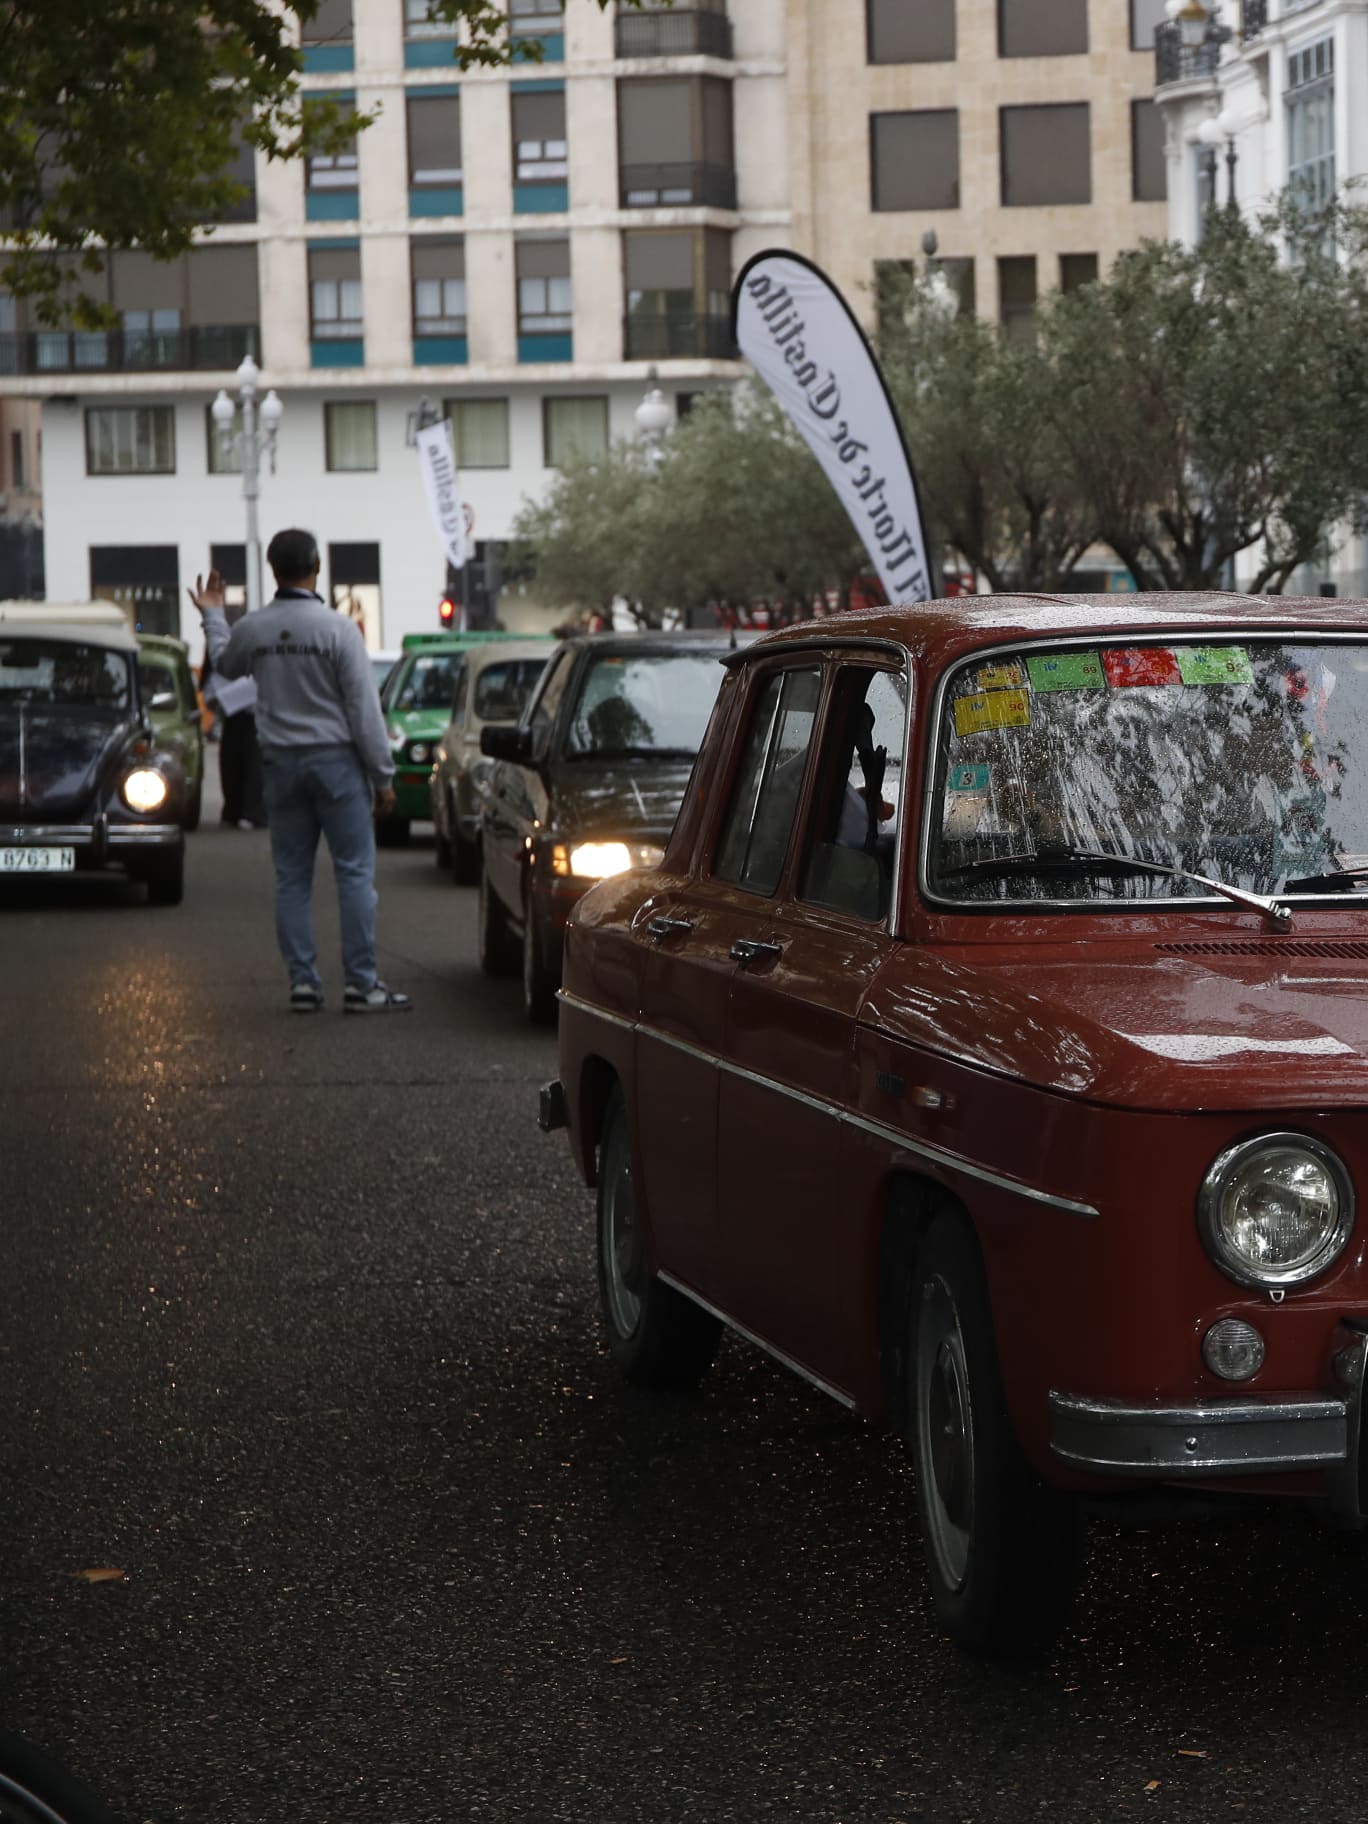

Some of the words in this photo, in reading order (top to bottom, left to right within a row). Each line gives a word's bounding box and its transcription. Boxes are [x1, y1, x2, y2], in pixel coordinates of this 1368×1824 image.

[1083, 666, 1097, 674] 89
[1009, 702, 1025, 712] 90
[962, 772, 973, 786] 3
